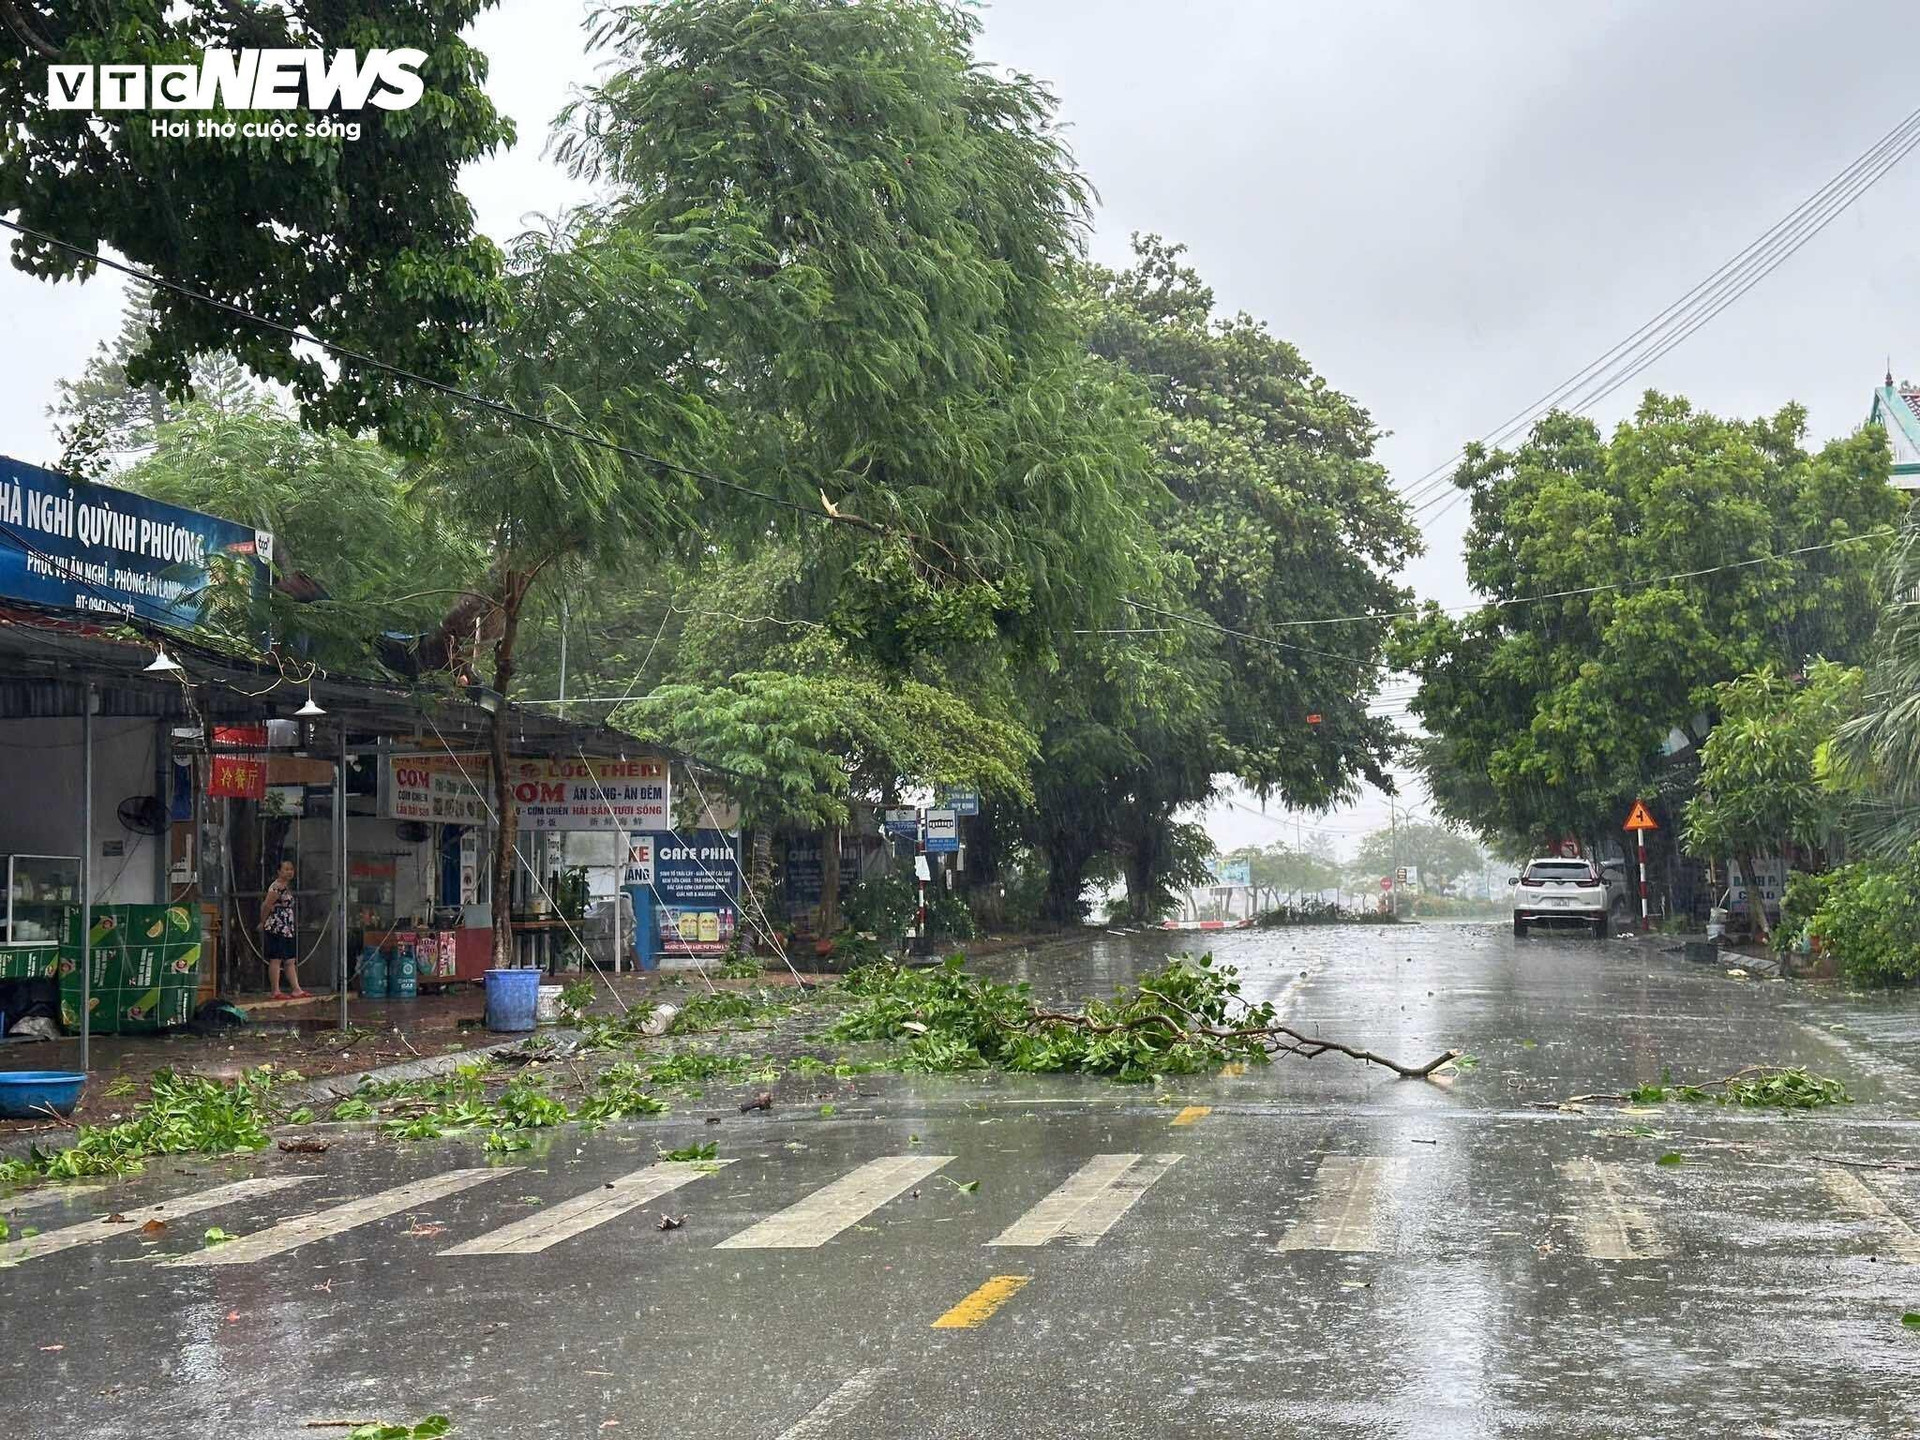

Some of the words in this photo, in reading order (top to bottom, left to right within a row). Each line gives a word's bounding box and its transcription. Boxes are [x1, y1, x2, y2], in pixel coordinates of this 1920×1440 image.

[28, 488, 74, 538] NGHỈ
[78, 502, 136, 552] QUỲNH
[140, 519, 205, 567] PHƯƠNG
[85, 561, 108, 586] NGHỈ
[114, 567, 145, 595] PHÒNG
[513, 781, 565, 803] ƠM
